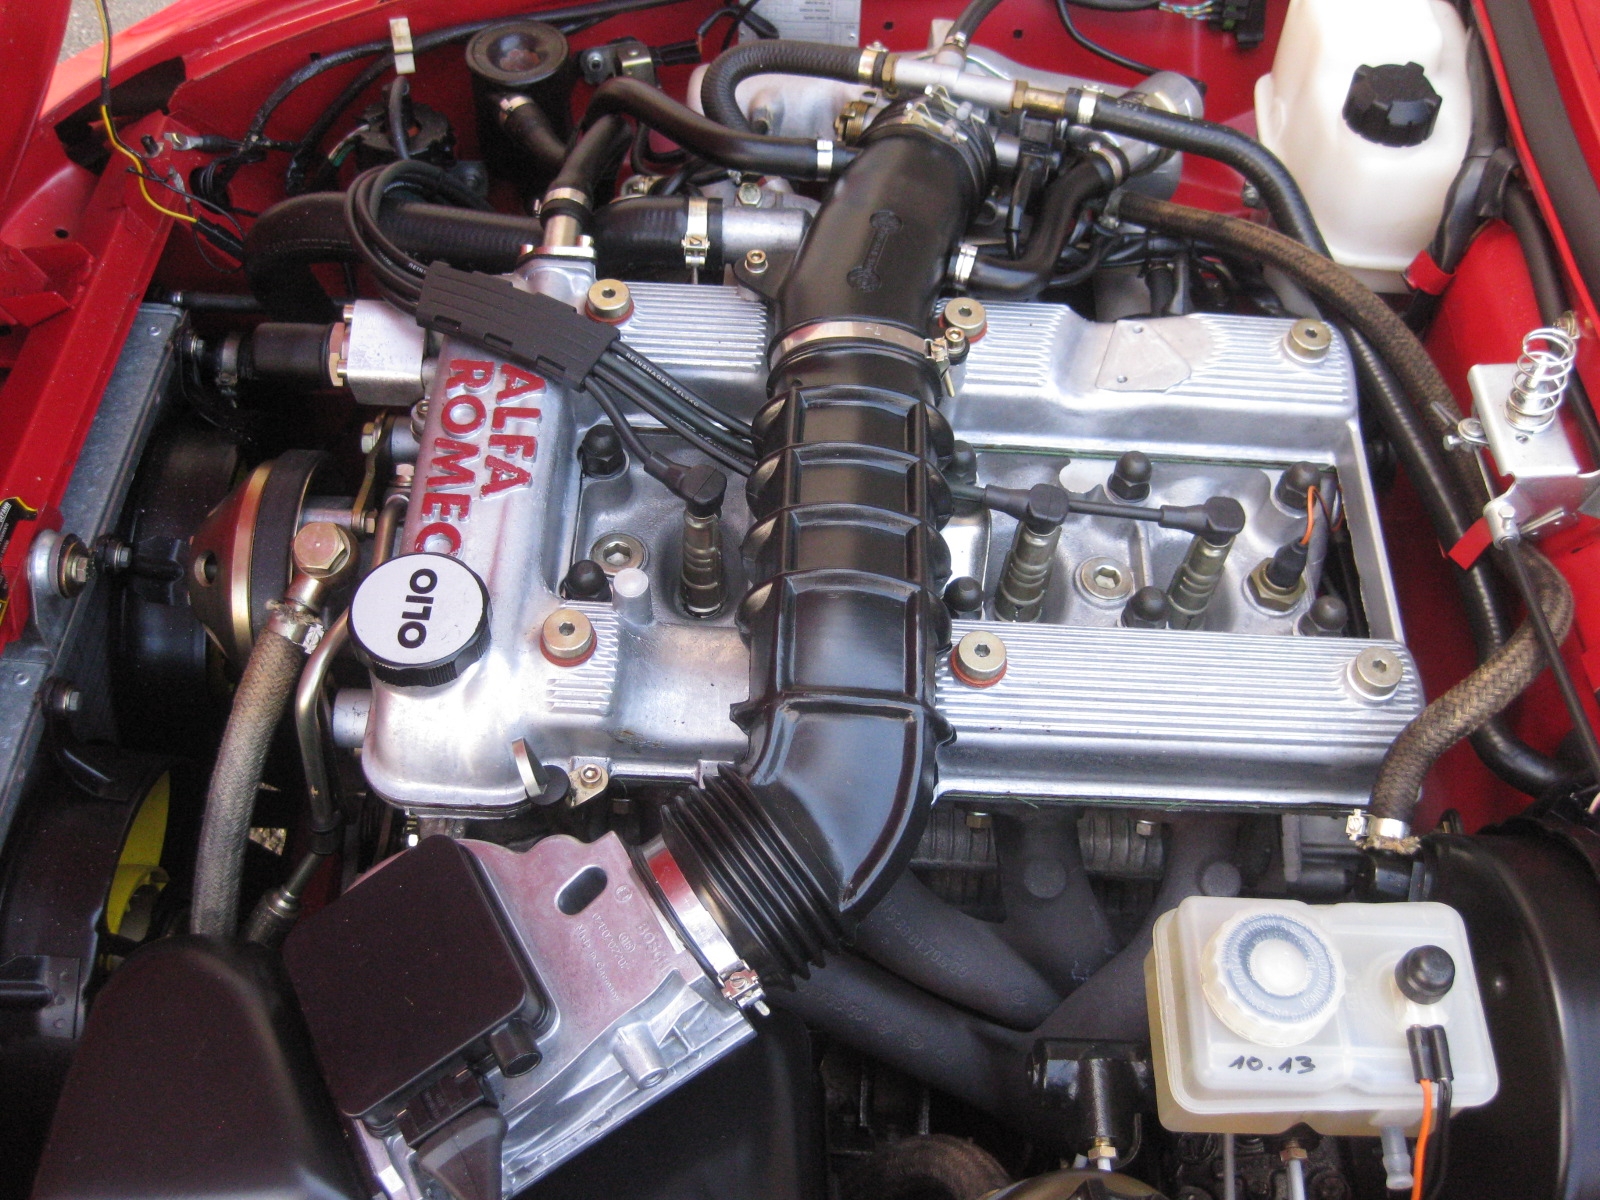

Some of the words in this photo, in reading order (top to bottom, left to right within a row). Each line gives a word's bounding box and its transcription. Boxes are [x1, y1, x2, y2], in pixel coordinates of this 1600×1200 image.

[625, 352, 671, 387] REINSHAGEN
[415, 359, 495, 555] ROMEO
[480, 363, 547, 501] ALFA
[397, 568, 438, 649] OLIO
[1228, 1055, 1315, 1074] 10.13
